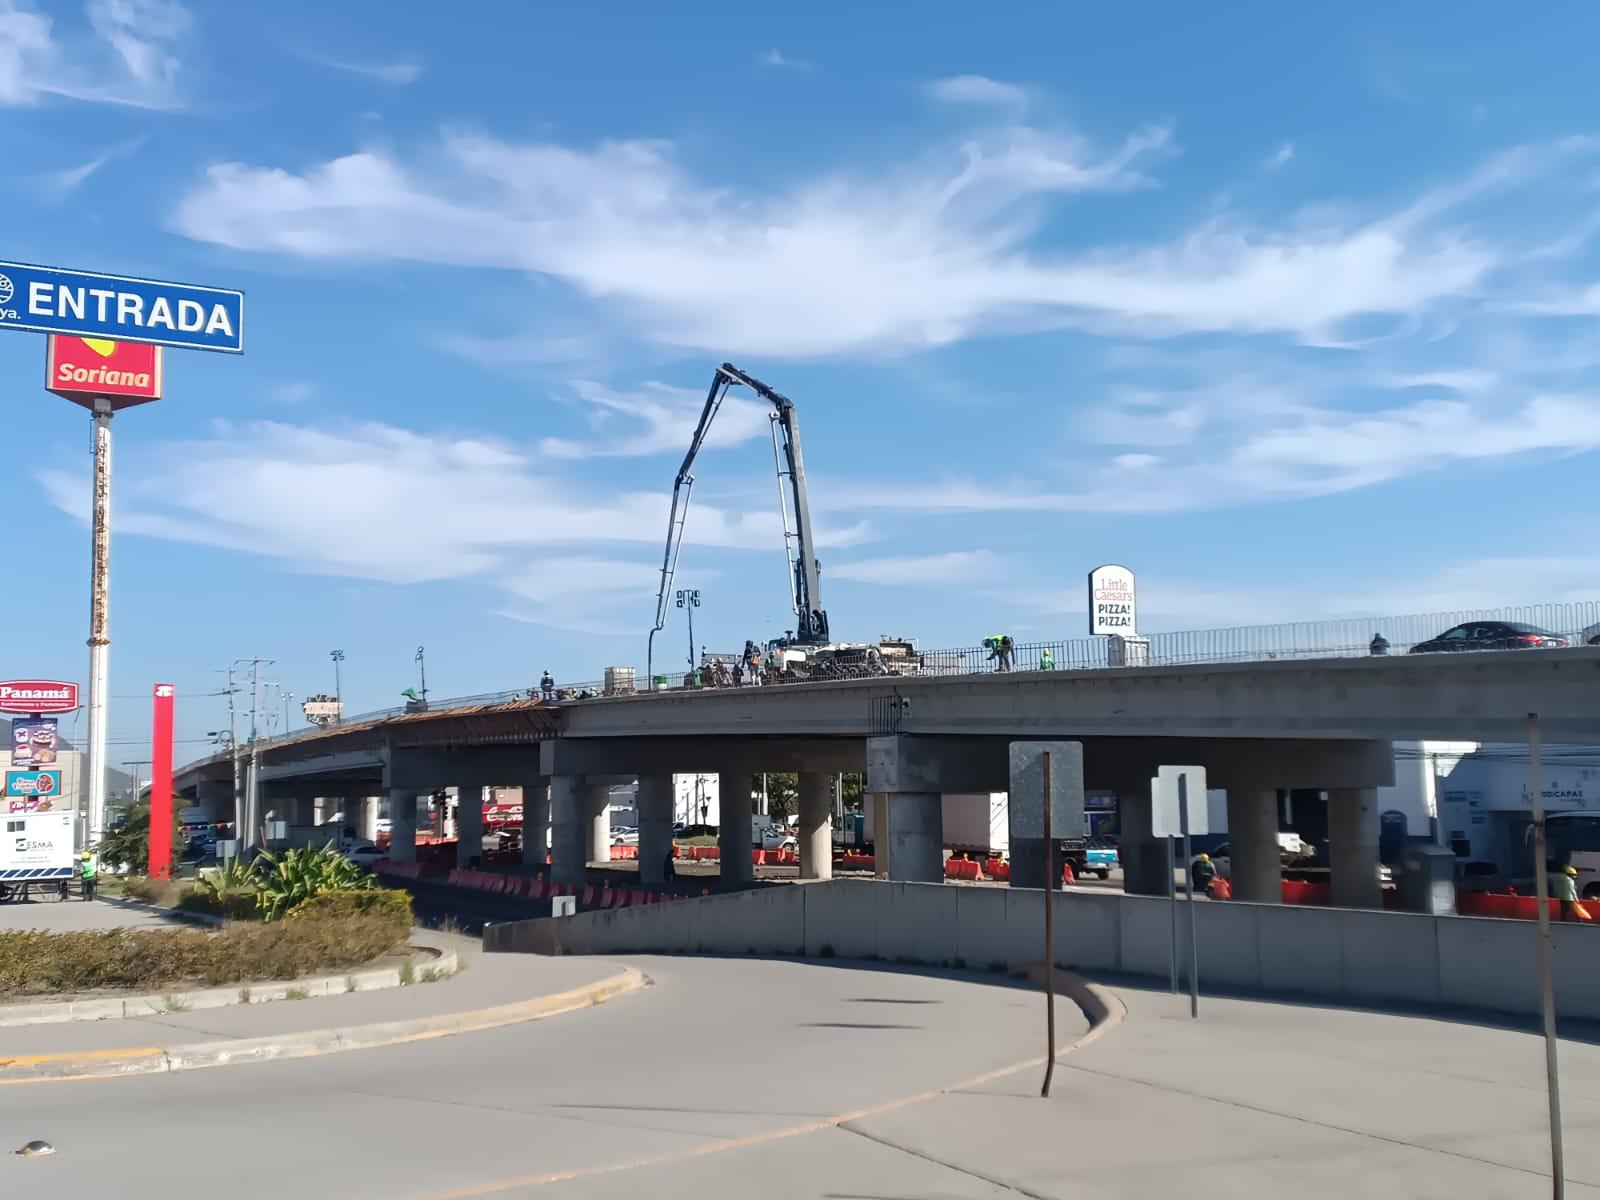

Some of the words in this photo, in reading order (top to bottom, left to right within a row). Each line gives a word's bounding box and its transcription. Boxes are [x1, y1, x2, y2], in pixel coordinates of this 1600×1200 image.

[28, 281, 234, 337] ENTRADA
[58, 362, 150, 388] Soriana
[1101, 578, 1128, 590] Little
[1094, 588, 1133, 601] Caesars
[1098, 604, 1131, 614] PIZZA!
[1098, 616, 1131, 627] PIZZA!
[0, 686, 70, 699] Panamá
